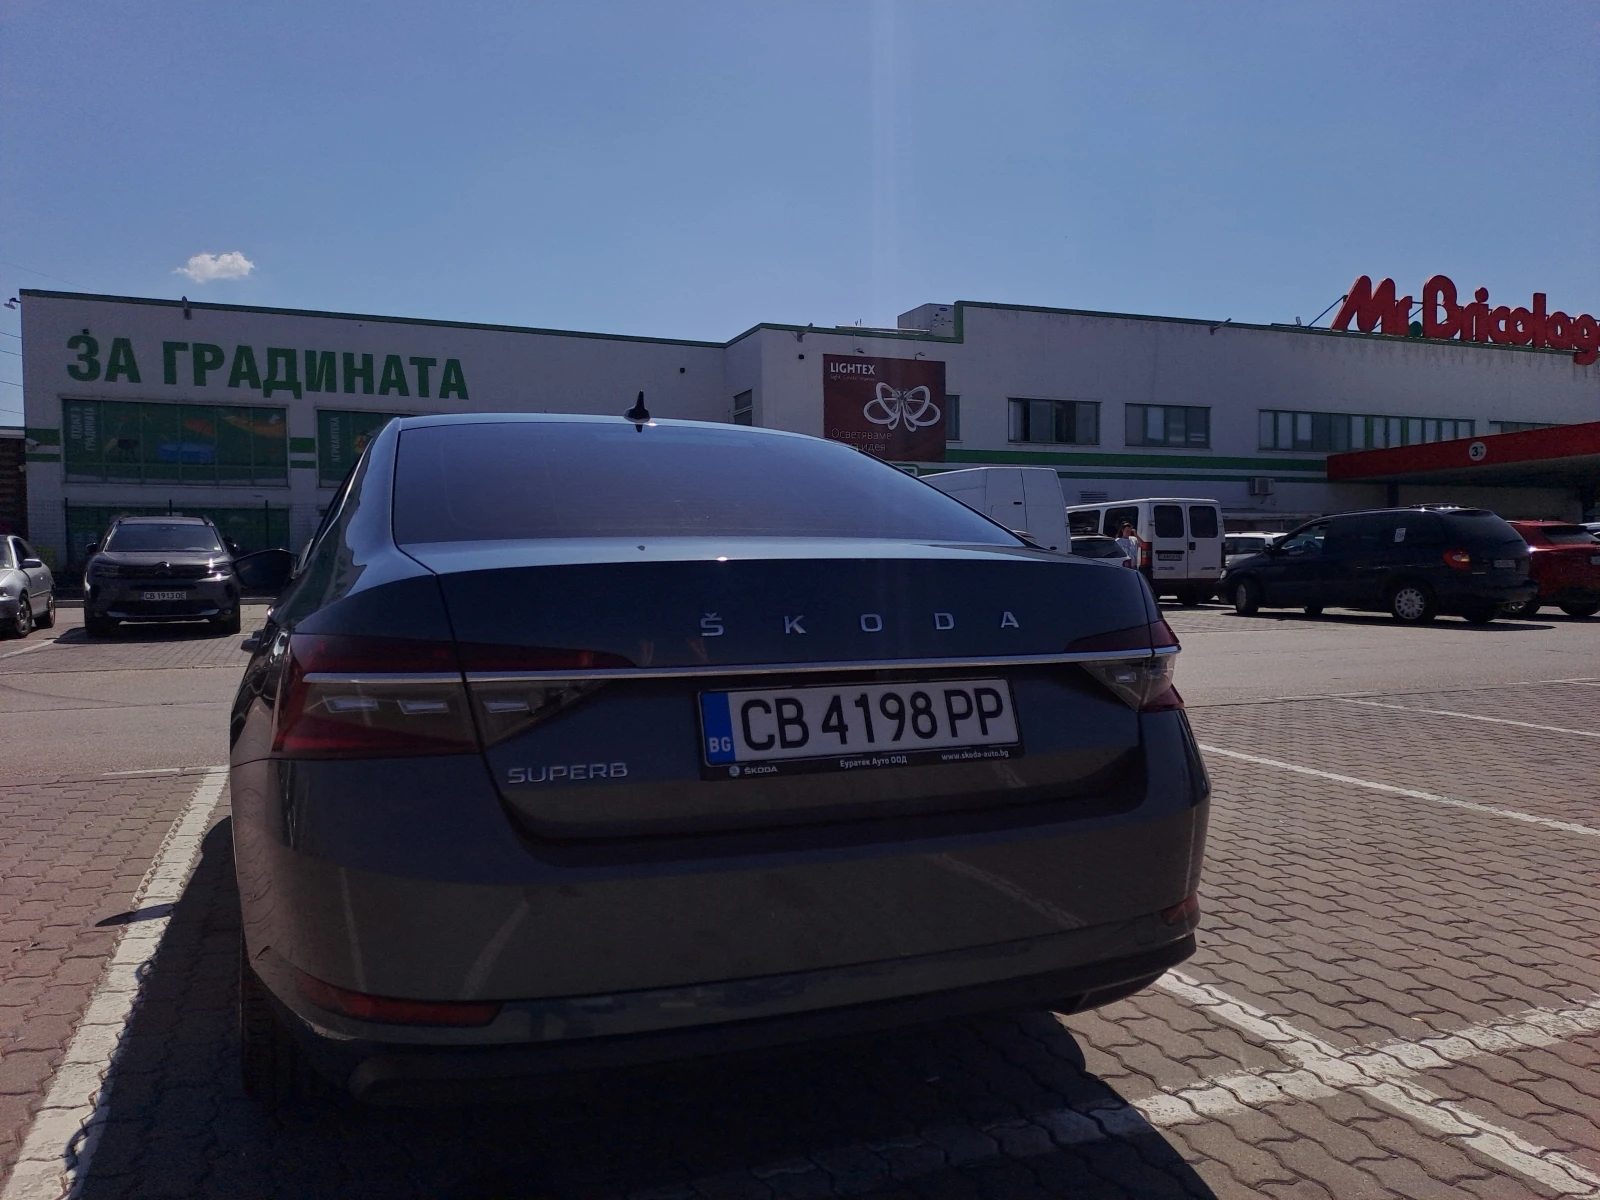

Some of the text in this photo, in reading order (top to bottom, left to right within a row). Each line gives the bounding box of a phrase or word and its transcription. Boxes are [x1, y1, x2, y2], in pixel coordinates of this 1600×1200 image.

[1424, 275, 1600, 365] Bricolag
[66, 333, 469, 400] ЗА ГРАДИНАТА
[830, 363, 875, 375] LIGHTEX
[832, 428, 892, 440] Осветяваме
[861, 443, 886, 453] идея
[708, 687, 1004, 754] BG CB 4198 PP
[941, 749, 1009, 761] www.skoda-auto.bg
[839, 755, 907, 769] Еуратек Ауто ООД
[507, 761, 628, 784] SUPERB
[744, 765, 778, 776] ŠKODA
